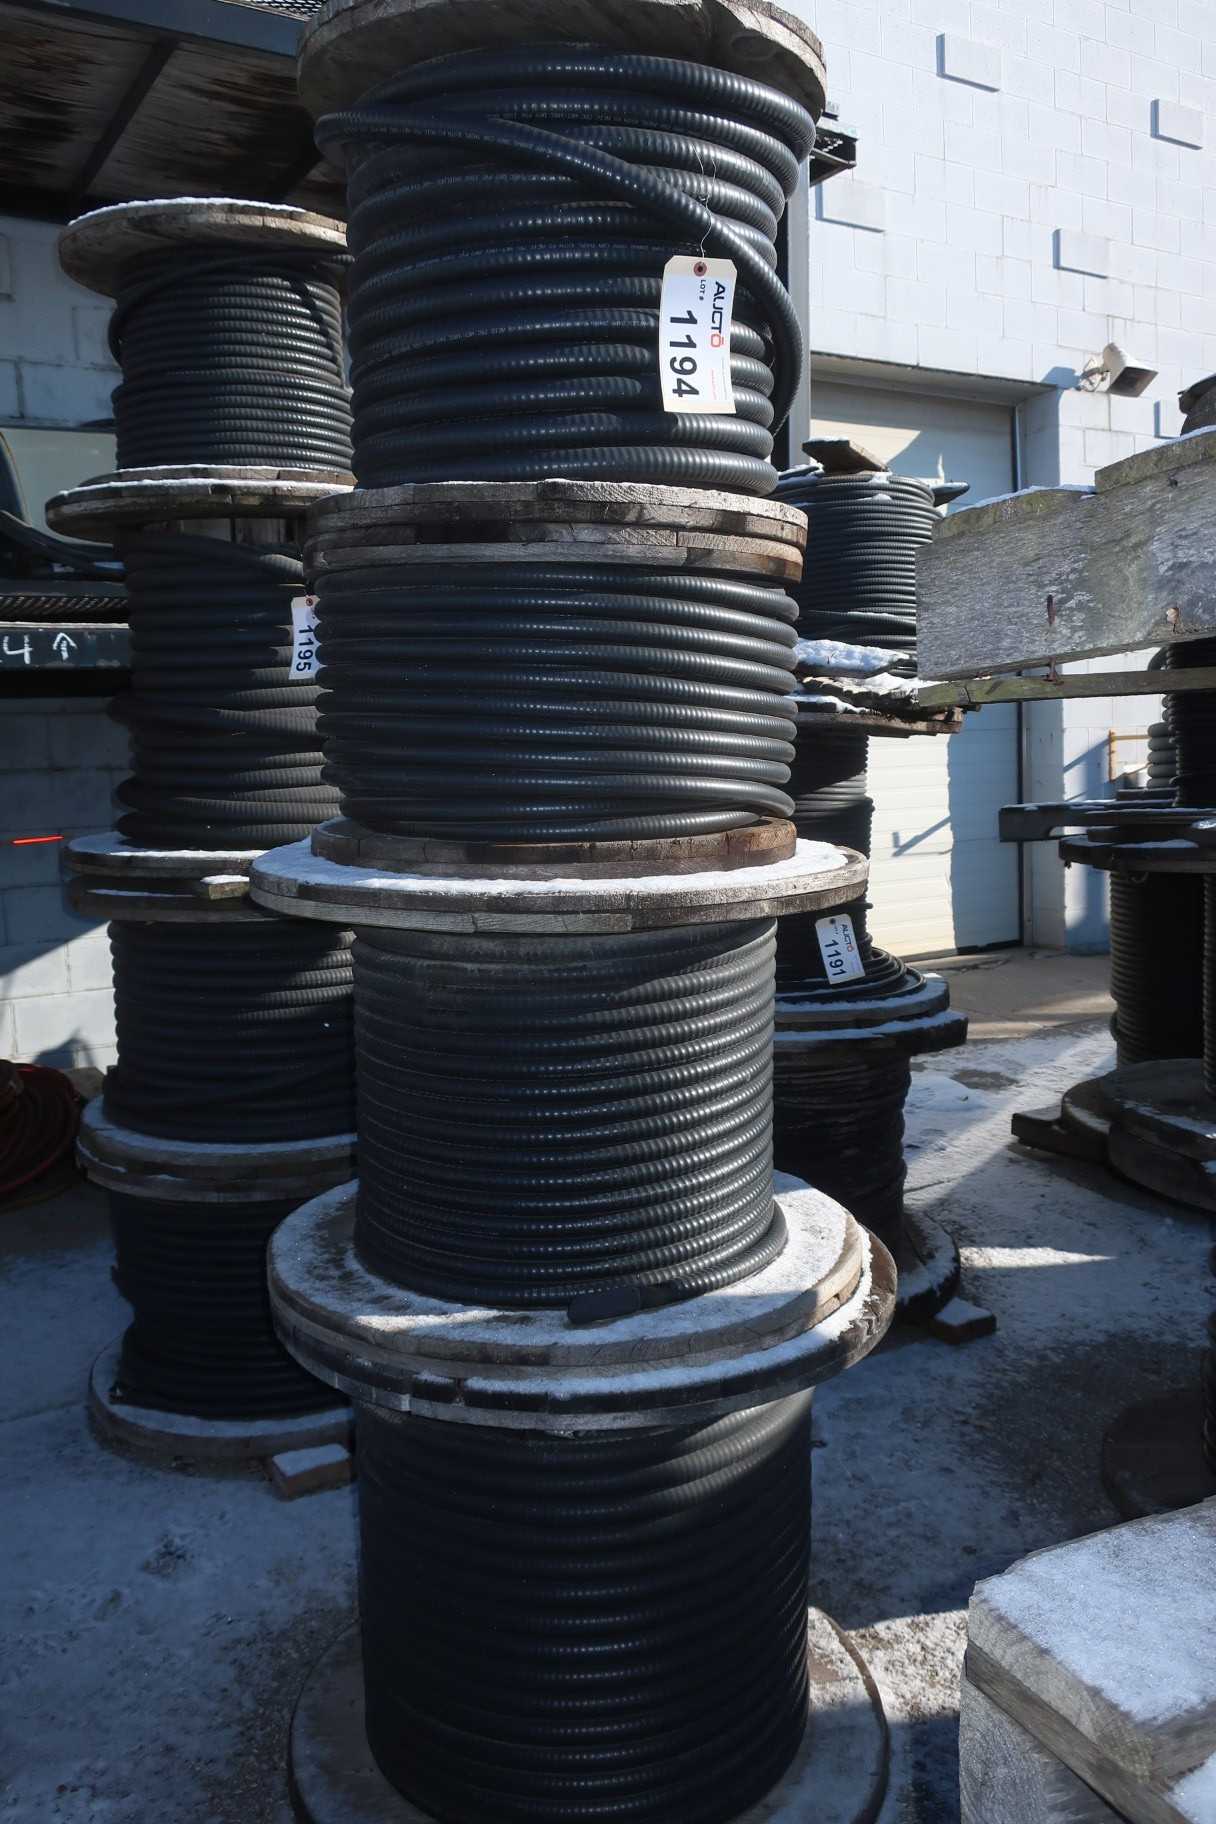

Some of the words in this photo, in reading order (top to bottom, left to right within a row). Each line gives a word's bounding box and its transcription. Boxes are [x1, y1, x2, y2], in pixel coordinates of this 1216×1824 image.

[669, 310, 700, 398] 1194
[296, 625, 314, 672] 1195
[824, 939, 847, 976] 1191
